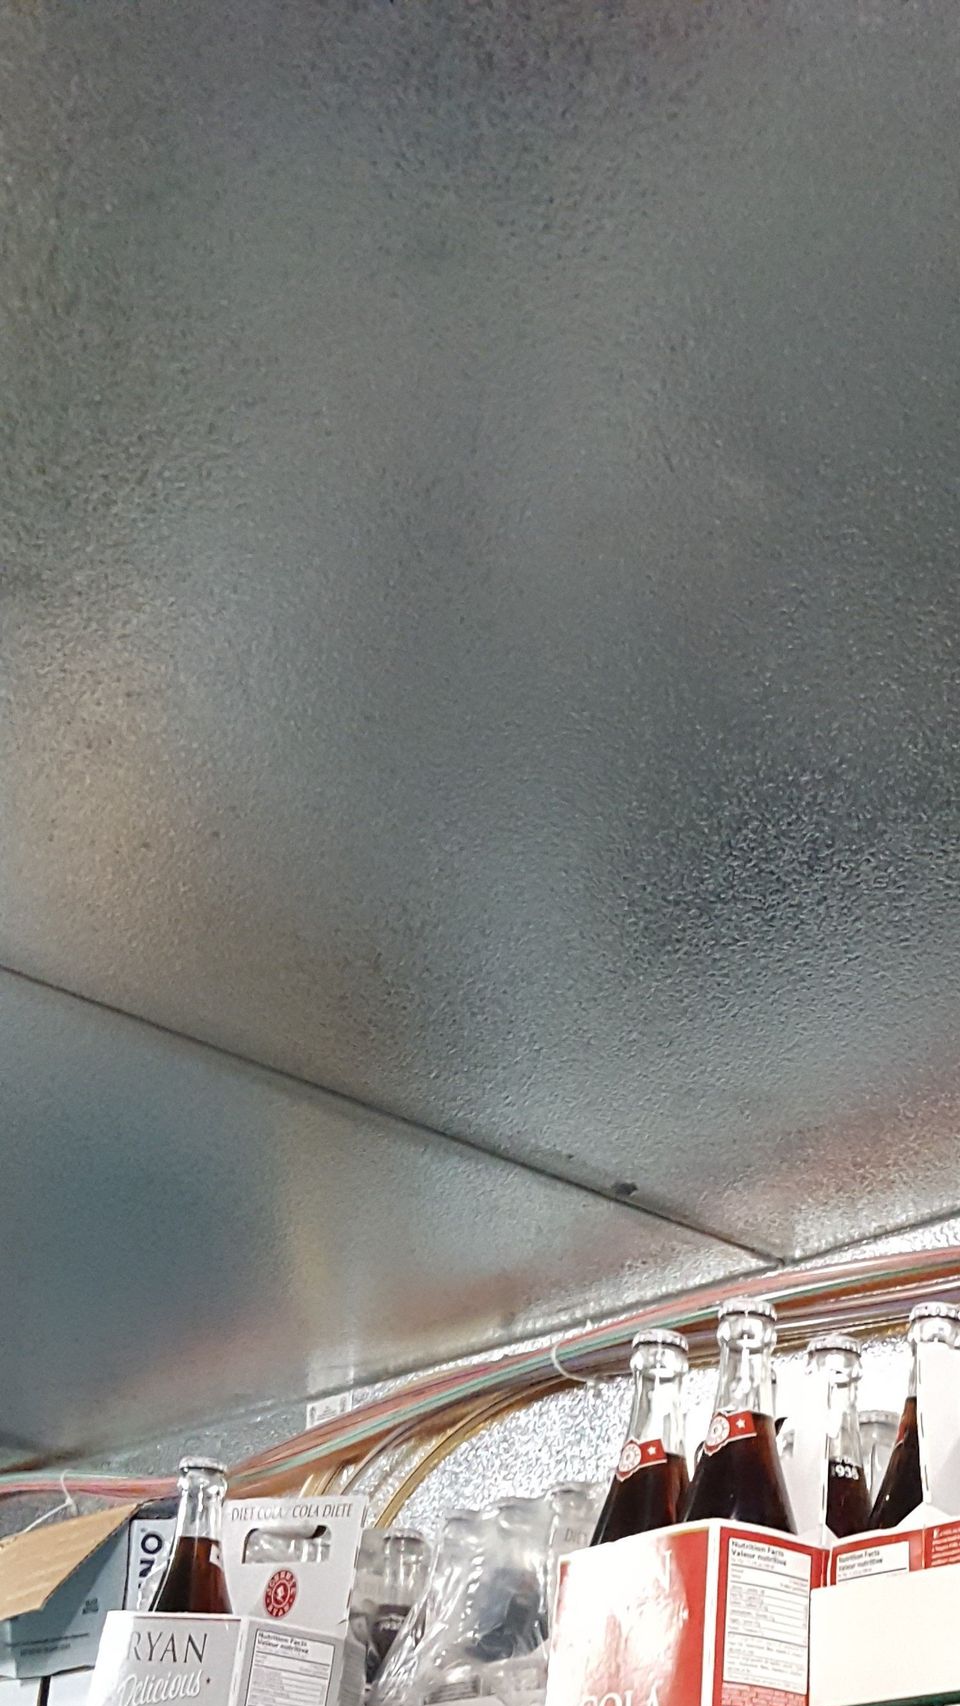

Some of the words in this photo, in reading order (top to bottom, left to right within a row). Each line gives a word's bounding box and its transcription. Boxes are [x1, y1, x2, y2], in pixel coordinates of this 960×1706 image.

[292, 1504, 318, 1519] COLA
[732, 1541, 766, 1554] Nutrition
[767, 1547, 784, 1557] Facts
[732, 1549, 756, 1560] Valeur
[757, 1554, 787, 1567] nutritive
[127, 1631, 208, 1664] RYAN
